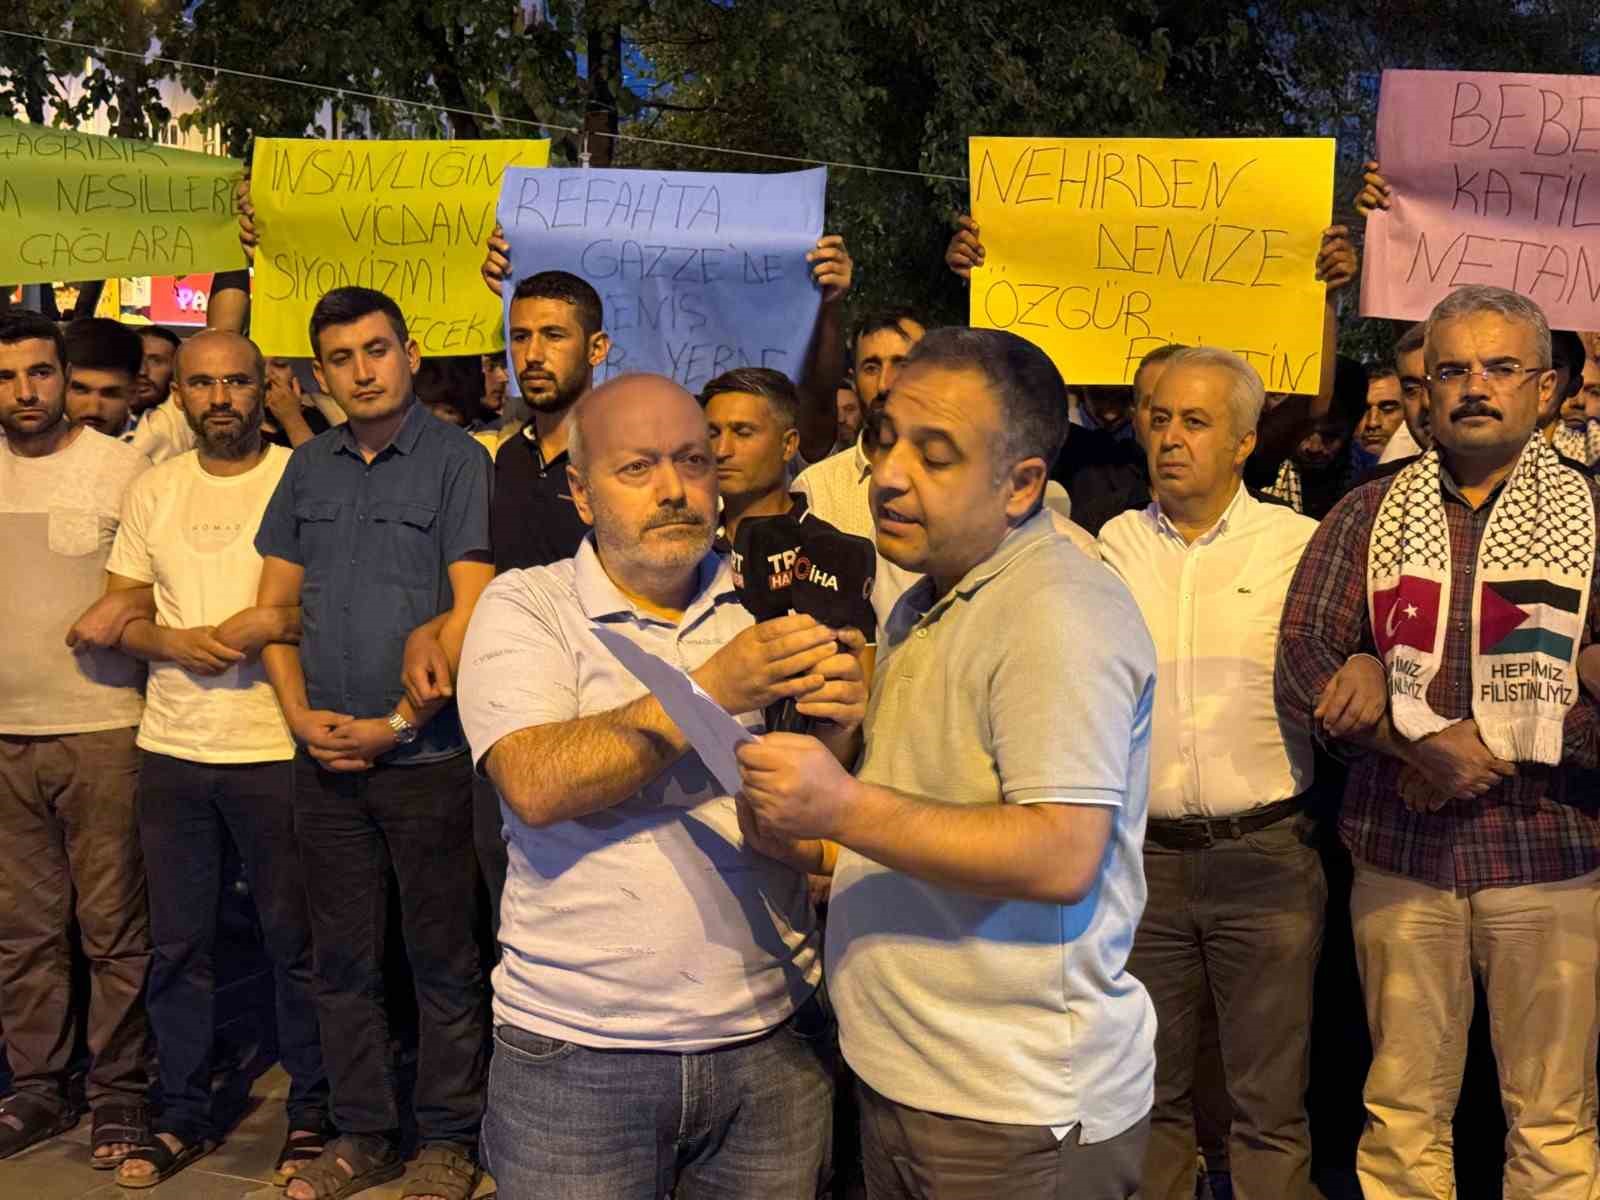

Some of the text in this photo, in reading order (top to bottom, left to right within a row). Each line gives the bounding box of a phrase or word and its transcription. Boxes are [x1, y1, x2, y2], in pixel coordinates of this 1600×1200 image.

[272, 145, 523, 195] İNSANLIĞIN
[976, 144, 1258, 210] NEHİRDEN
[20, 225, 195, 270] ÇAĞLARA
[1096, 216, 1289, 287] DENİZE
[984, 265, 1151, 336] ÖZGÜR
[768, 546, 802, 574] TR
[809, 565, 839, 591] İHA
[1481, 679, 1573, 706] FİLİSTİNLİYİZ
[1491, 660, 1564, 681] HEPİMİZ
